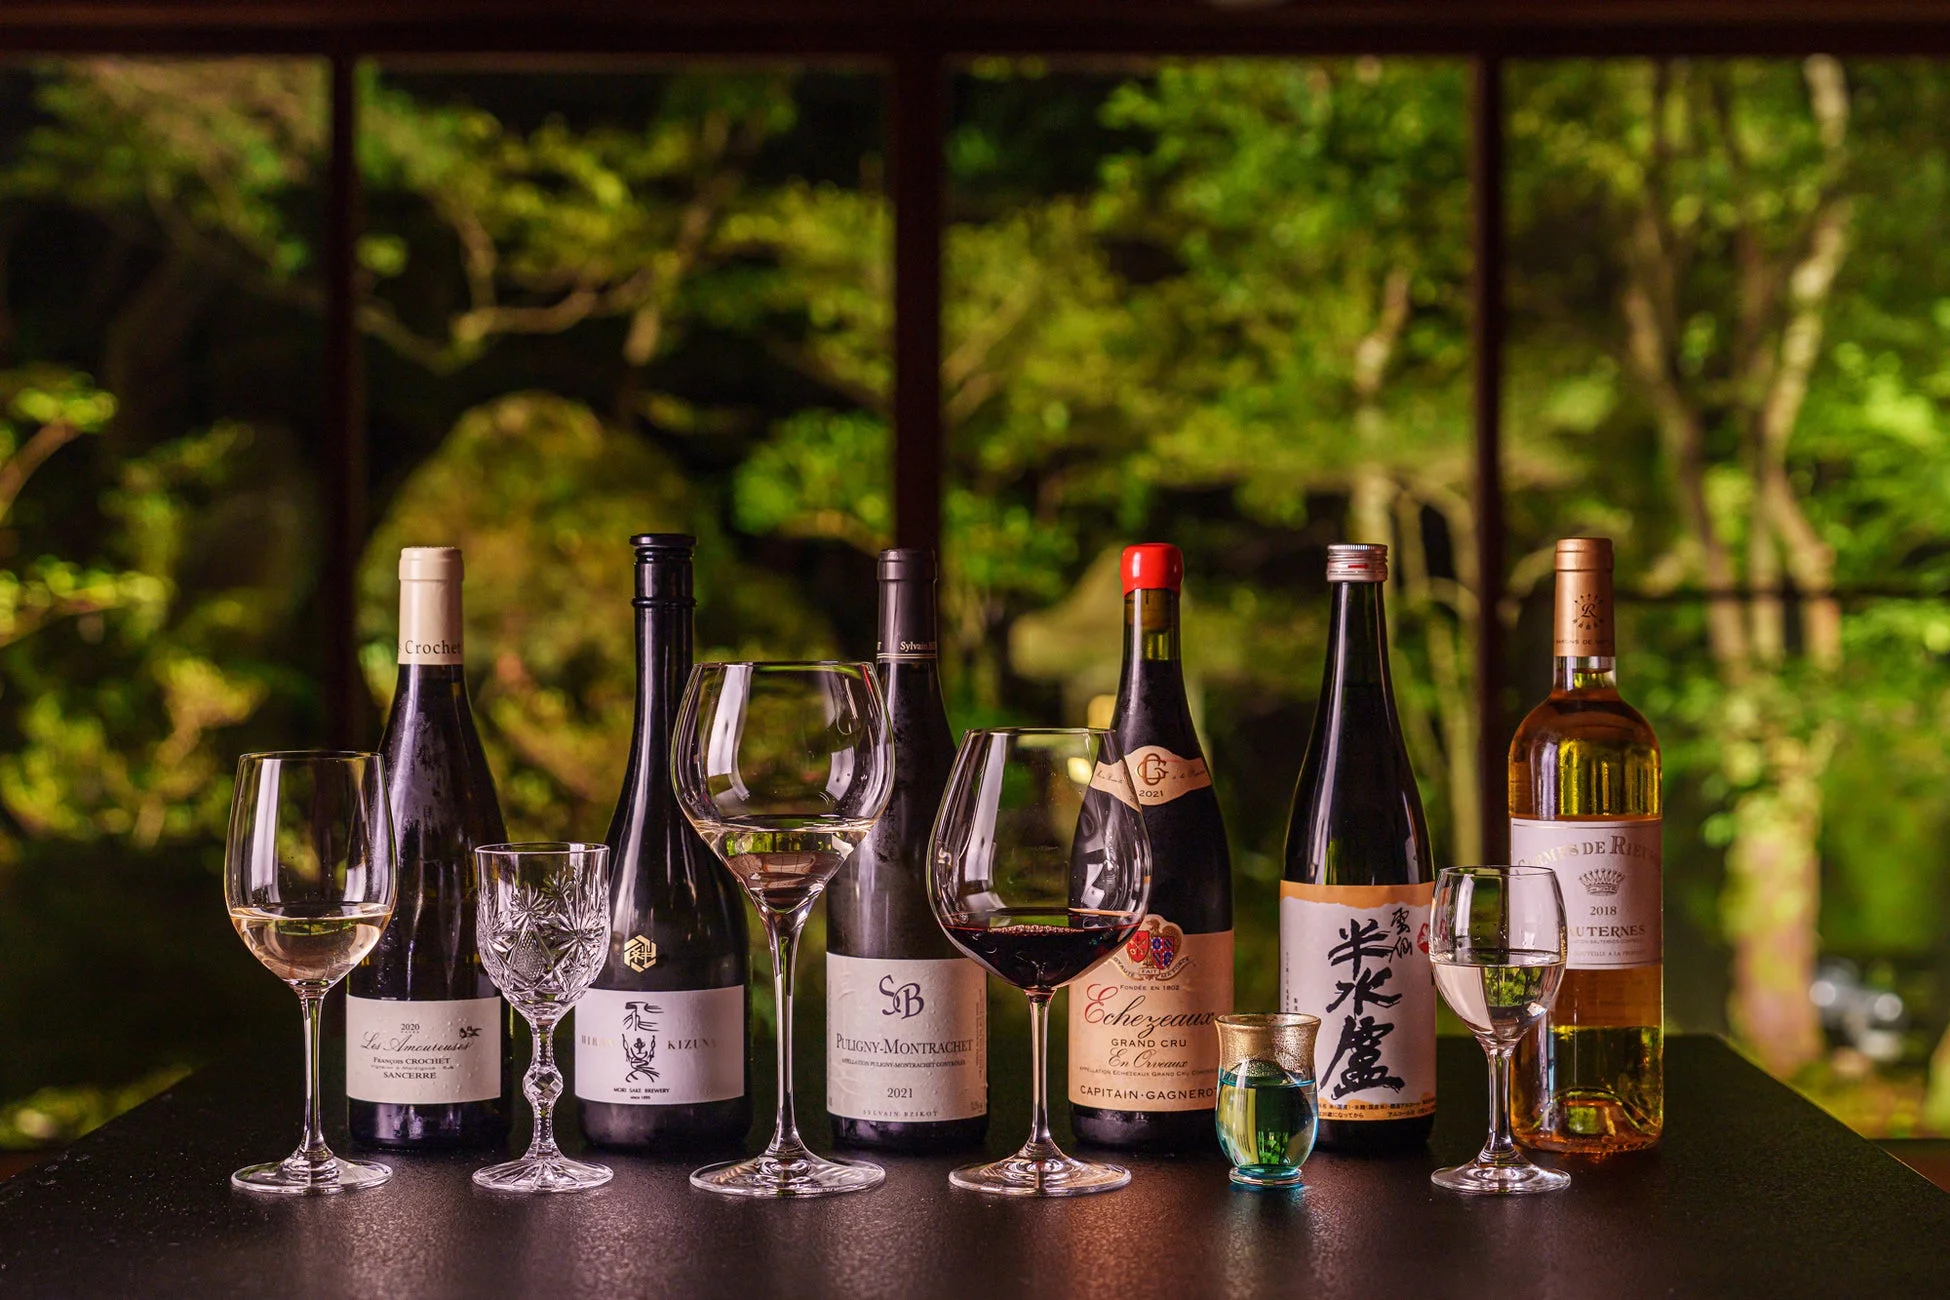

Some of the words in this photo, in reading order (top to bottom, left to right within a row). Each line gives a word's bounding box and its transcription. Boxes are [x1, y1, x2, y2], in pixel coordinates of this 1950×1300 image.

[405, 640, 461, 654] Crochet
[1139, 790, 1164, 798] 2021
[1583, 841, 1606, 855] DE
[1590, 906, 1618, 916] 2018
[1568, 925, 1646, 938] AUTERNES
[360, 1031, 381, 1050] Les
[383, 1034, 473, 1052] Amoureuses
[836, 1033, 973, 1054] PULIGNY-MONTRACHET
[1111, 1039, 1156, 1048] GRAND
[1160, 1039, 1188, 1048] CRU
[405, 1057, 452, 1065] CROCHET
[1108, 1048, 1130, 1068] En
[1133, 1049, 1189, 1068] Orveaux
[383, 1071, 437, 1080] SANCERRE
[887, 1088, 913, 1098] 2021
